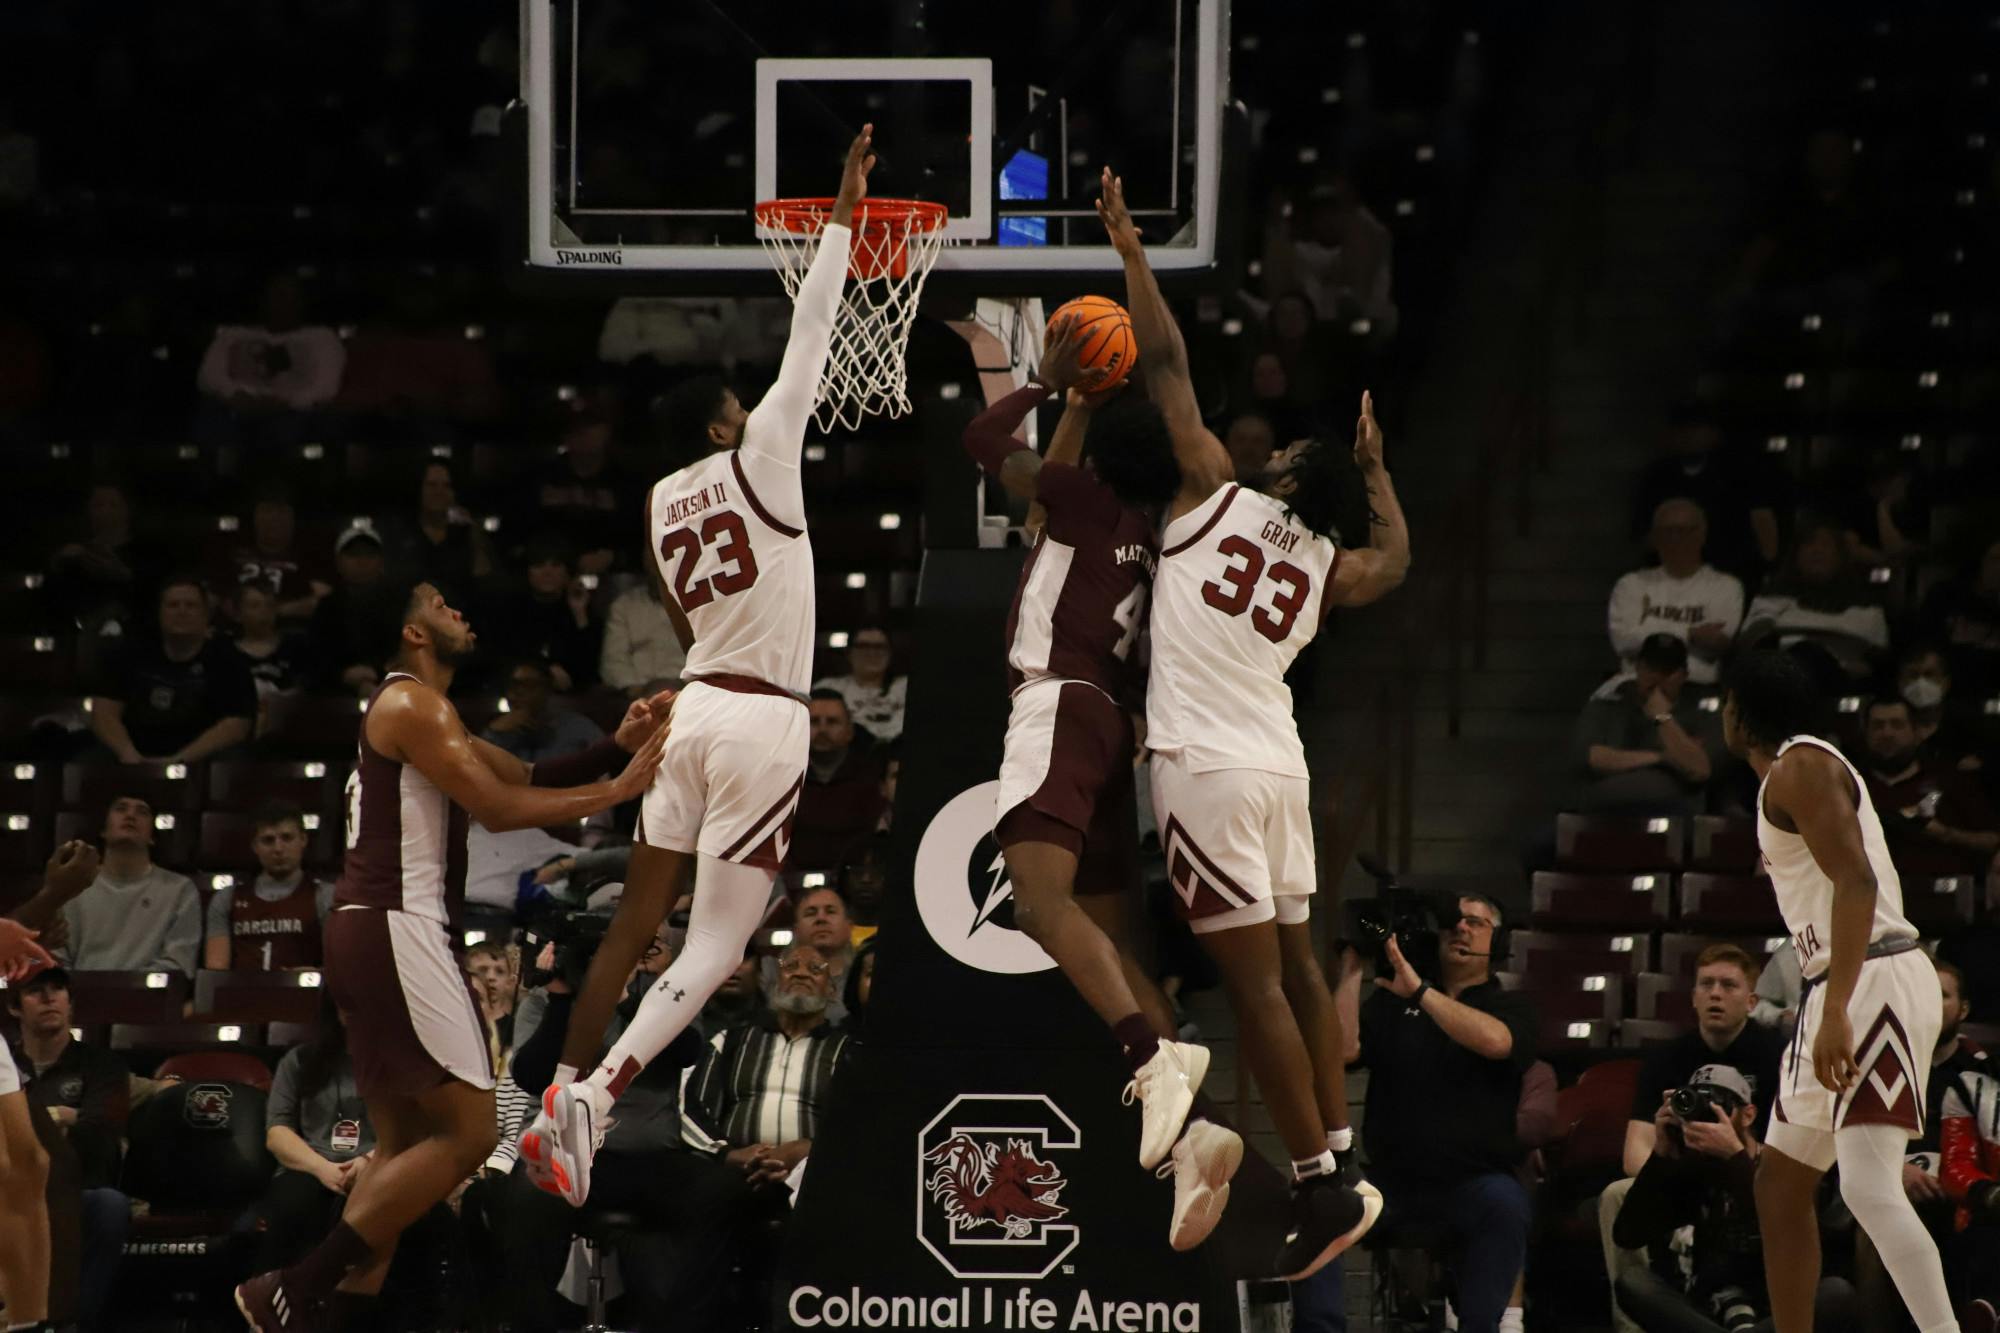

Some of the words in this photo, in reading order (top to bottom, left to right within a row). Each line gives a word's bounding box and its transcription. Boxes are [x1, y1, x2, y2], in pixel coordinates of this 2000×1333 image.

[557, 250, 622, 265] SPALDING
[664, 488, 712, 527] JACKSON
[713, 482, 728, 504] II
[1261, 520, 1300, 553] GRAY
[661, 510, 759, 614] 23
[1201, 534, 1310, 644] 33
[1112, 581, 1147, 663] 4
[233, 918, 304, 936] CAROLINA
[260, 940, 273, 972] 1
[788, 1285, 971, 1329] Colonial
[1068, 1288, 1200, 1333] Arena
